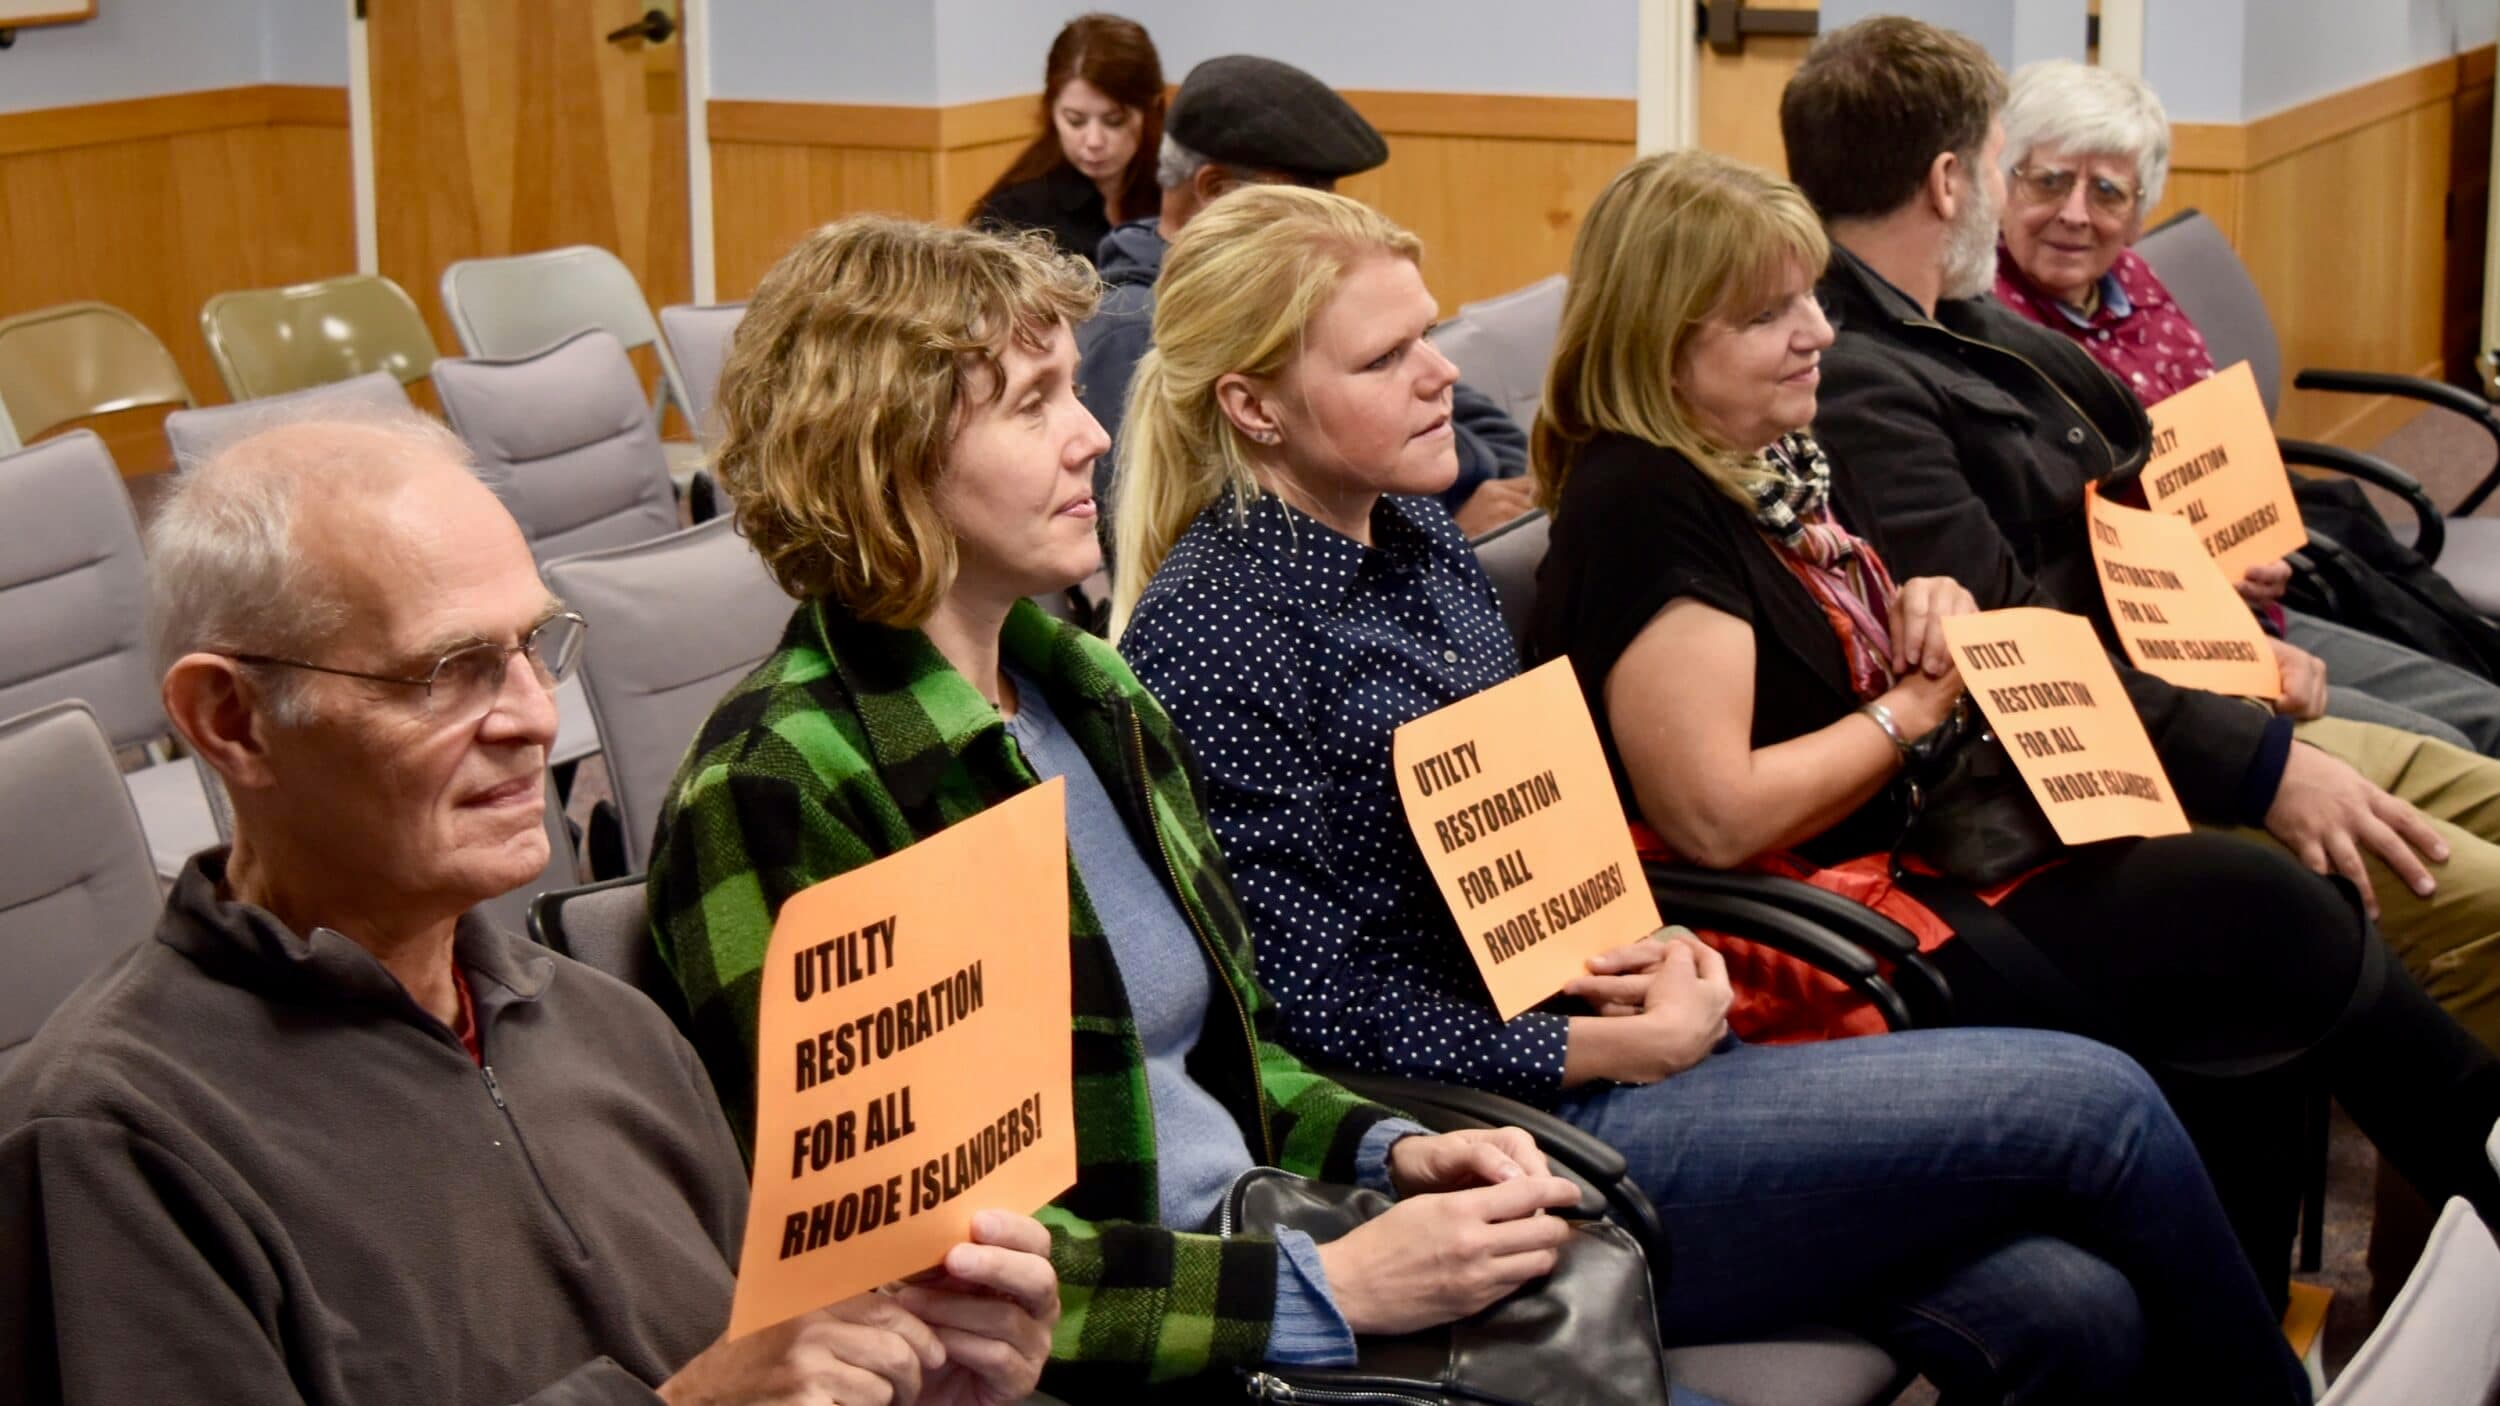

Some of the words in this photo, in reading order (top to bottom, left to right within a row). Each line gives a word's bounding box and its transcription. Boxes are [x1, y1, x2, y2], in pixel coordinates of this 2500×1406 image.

[2151, 428, 2178, 459] ILTY
[2155, 444, 2228, 499] RESTORATION
[2187, 498, 2208, 525] ALL
[2213, 501, 2279, 554] ISLANDERS!
[2103, 558, 2184, 591] RESTORATION
[2117, 599, 2144, 622] FOR
[2141, 602, 2168, 624] ALL
[1961, 639, 2025, 670] UTILTY
[2136, 638, 2185, 660] RHODE
[2180, 640, 2259, 662] ISLANDERS!
[1988, 680, 2097, 714] RESTORATION
[1412, 740, 1481, 797] UTILTY
[2014, 731, 2055, 758] FOR
[2052, 726, 2086, 754] ALL
[1434, 769, 1562, 854] RESTORATION
[2041, 771, 2105, 803] RHODE
[1458, 865, 1500, 910] FOR
[1499, 849, 1533, 894] ALL
[1482, 911, 1547, 964] RHODE
[1541, 862, 1627, 935] ISLANDERS!
[794, 915, 897, 1003] UTILTY
[795, 959, 984, 1093] RESTORATION
[791, 1109, 857, 1180] FOR
[863, 1086, 916, 1153] ALL
[779, 1176, 901, 1260] RHODE
[909, 1092, 1042, 1218] ISLANDERS!
